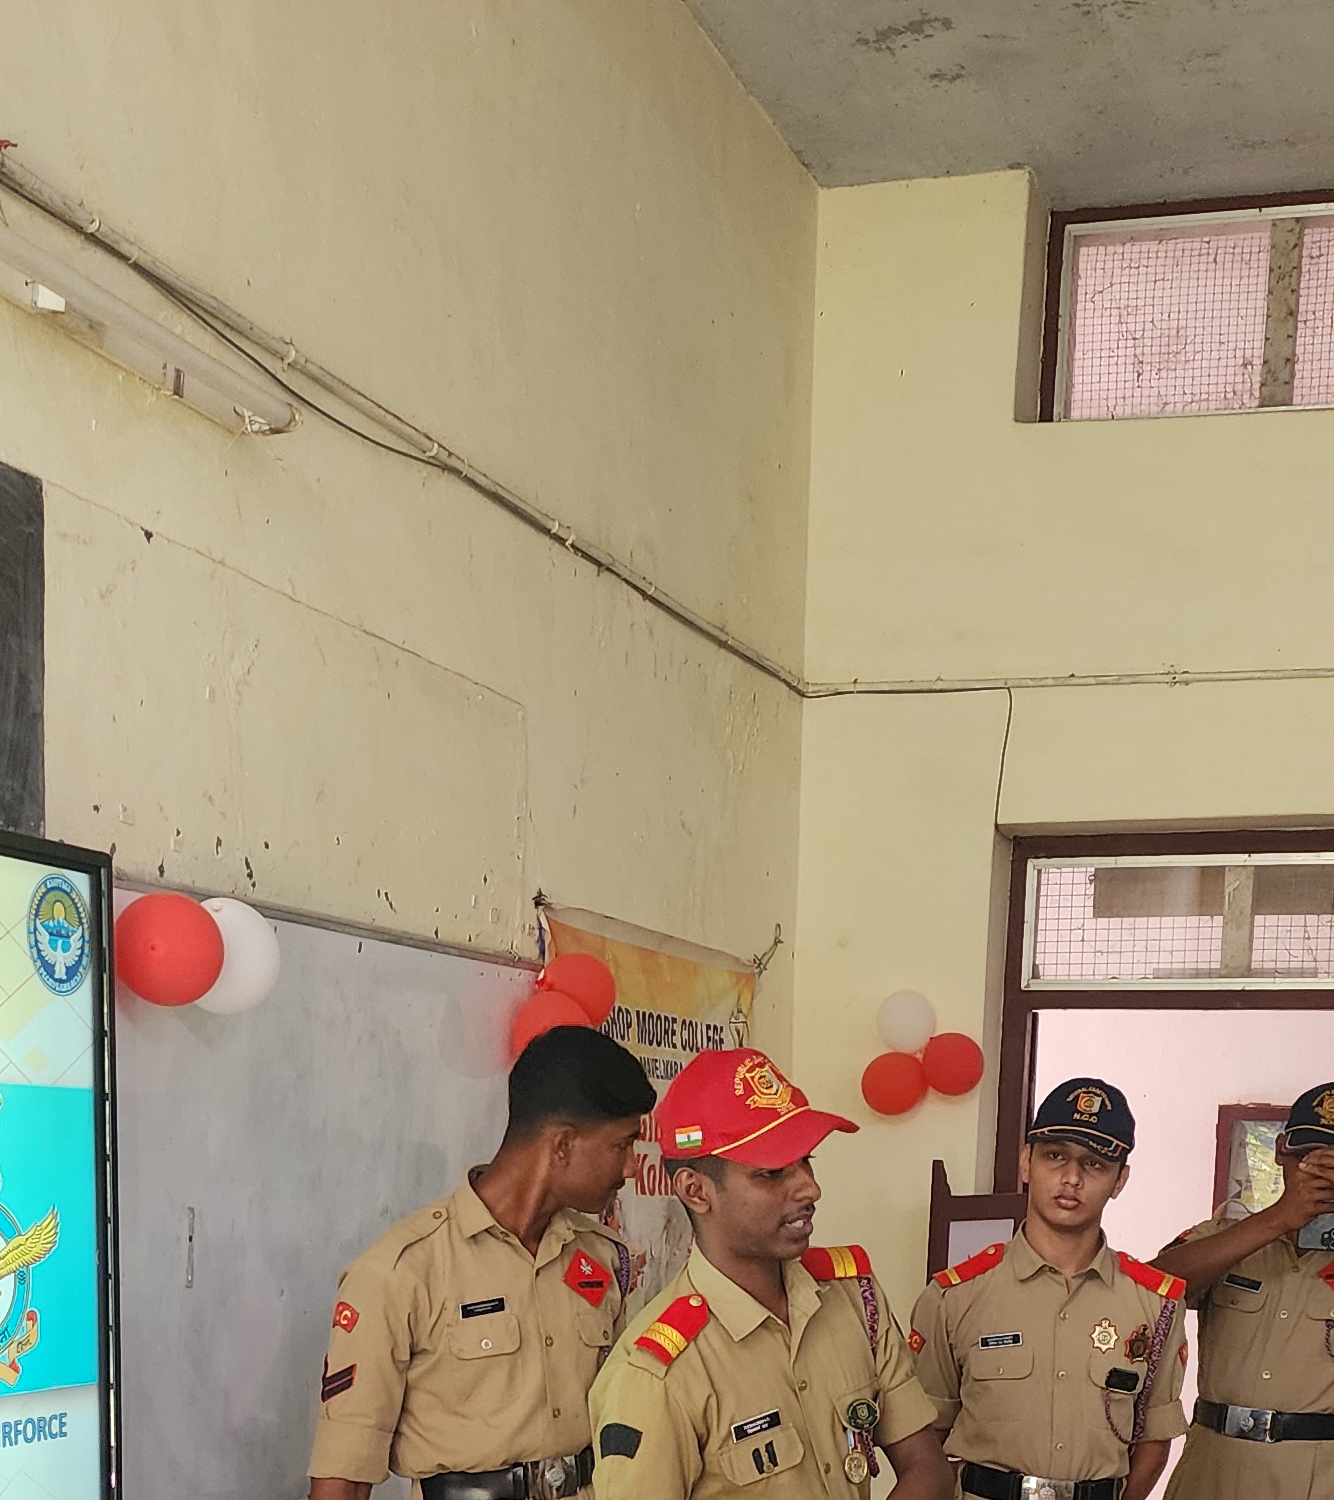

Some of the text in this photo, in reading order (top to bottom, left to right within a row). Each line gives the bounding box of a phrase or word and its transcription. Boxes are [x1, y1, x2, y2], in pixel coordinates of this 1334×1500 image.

[600, 1005, 725, 1054] SHOP MOORE COLLEGE
